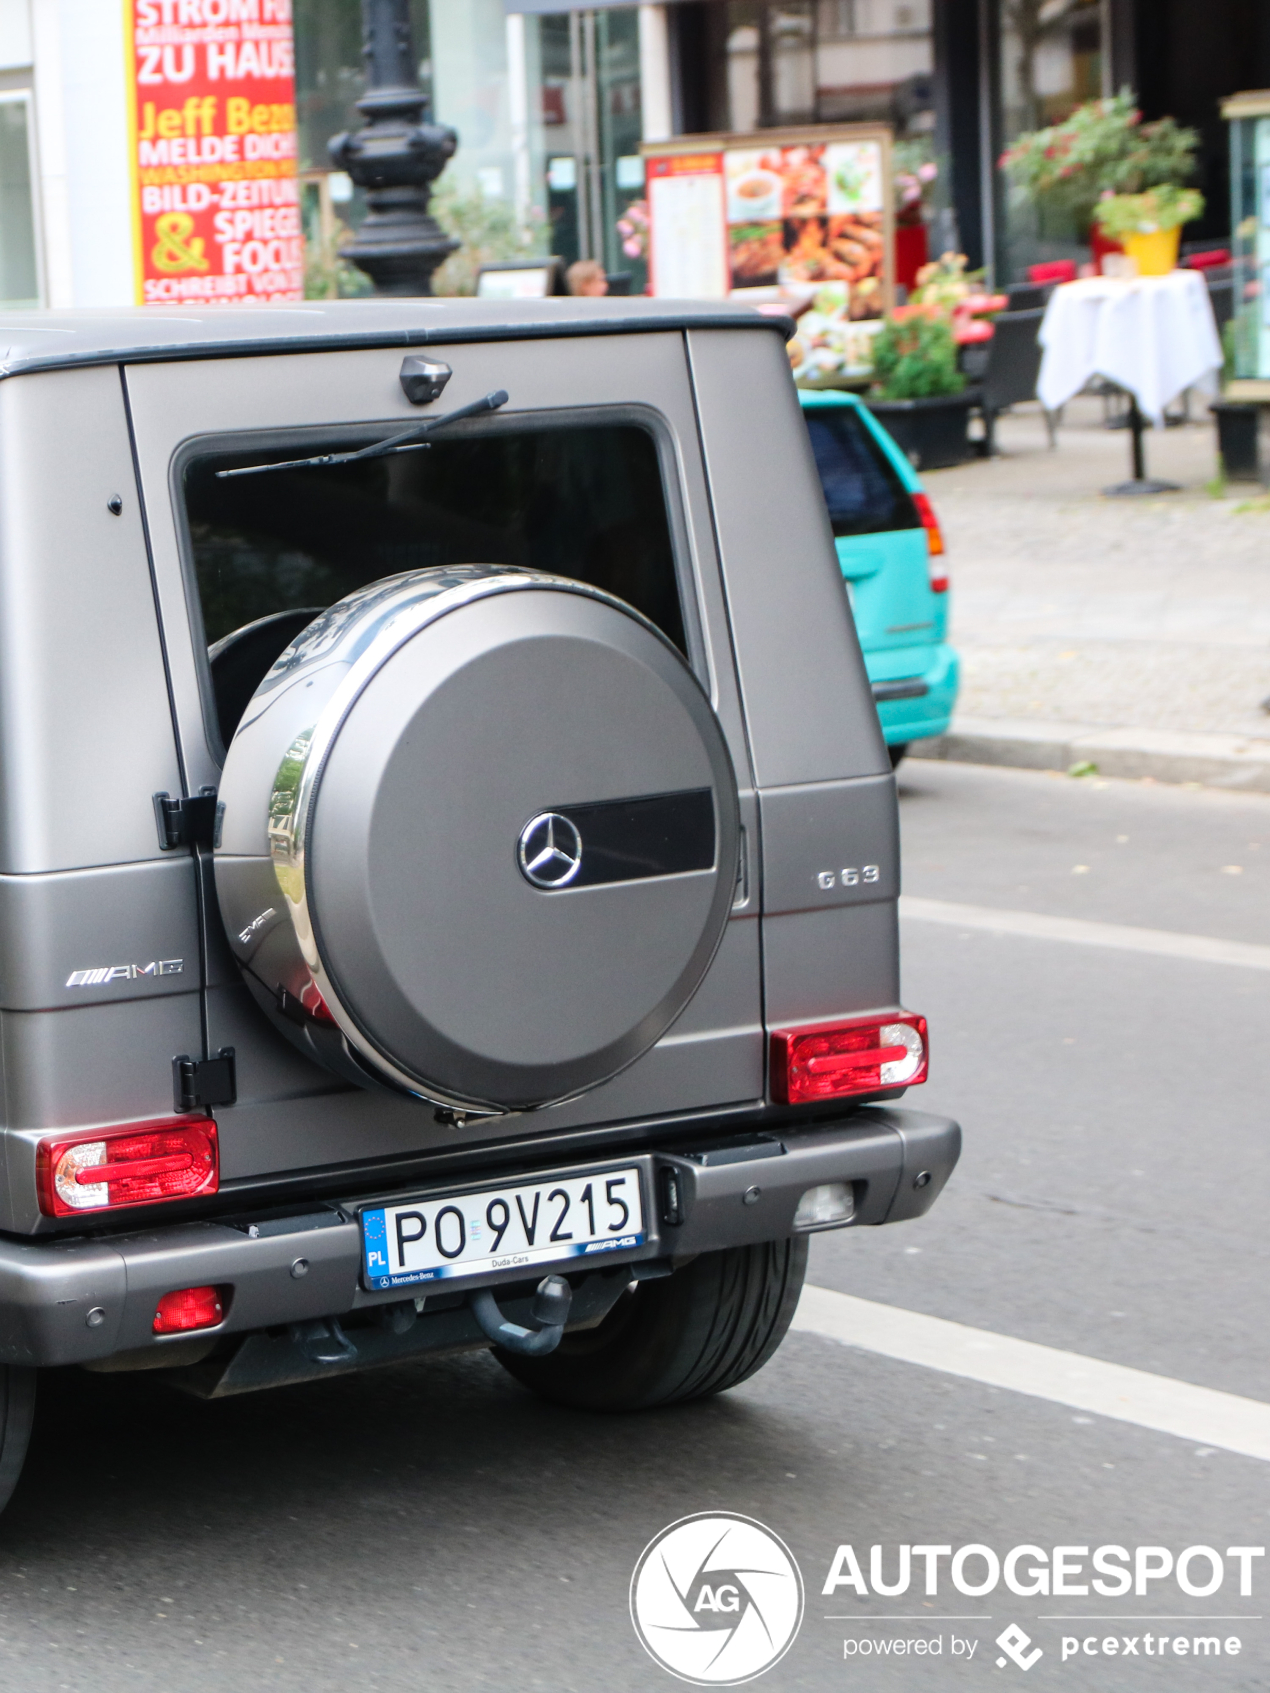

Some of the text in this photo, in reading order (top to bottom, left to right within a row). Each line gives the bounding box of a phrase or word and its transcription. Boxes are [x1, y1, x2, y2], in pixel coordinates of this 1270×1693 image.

[135, 0, 259, 27] STROM
[137, 45, 195, 84] ZU
[139, 95, 217, 139] Jeff
[139, 134, 240, 166] MELDE
[151, 211, 210, 272] &
[368, 1177, 630, 1267] PL PO 9V215
[391, 1271, 435, 1285] Mercedes-Benz
[491, 1255, 529, 1269] Duda-Cars
